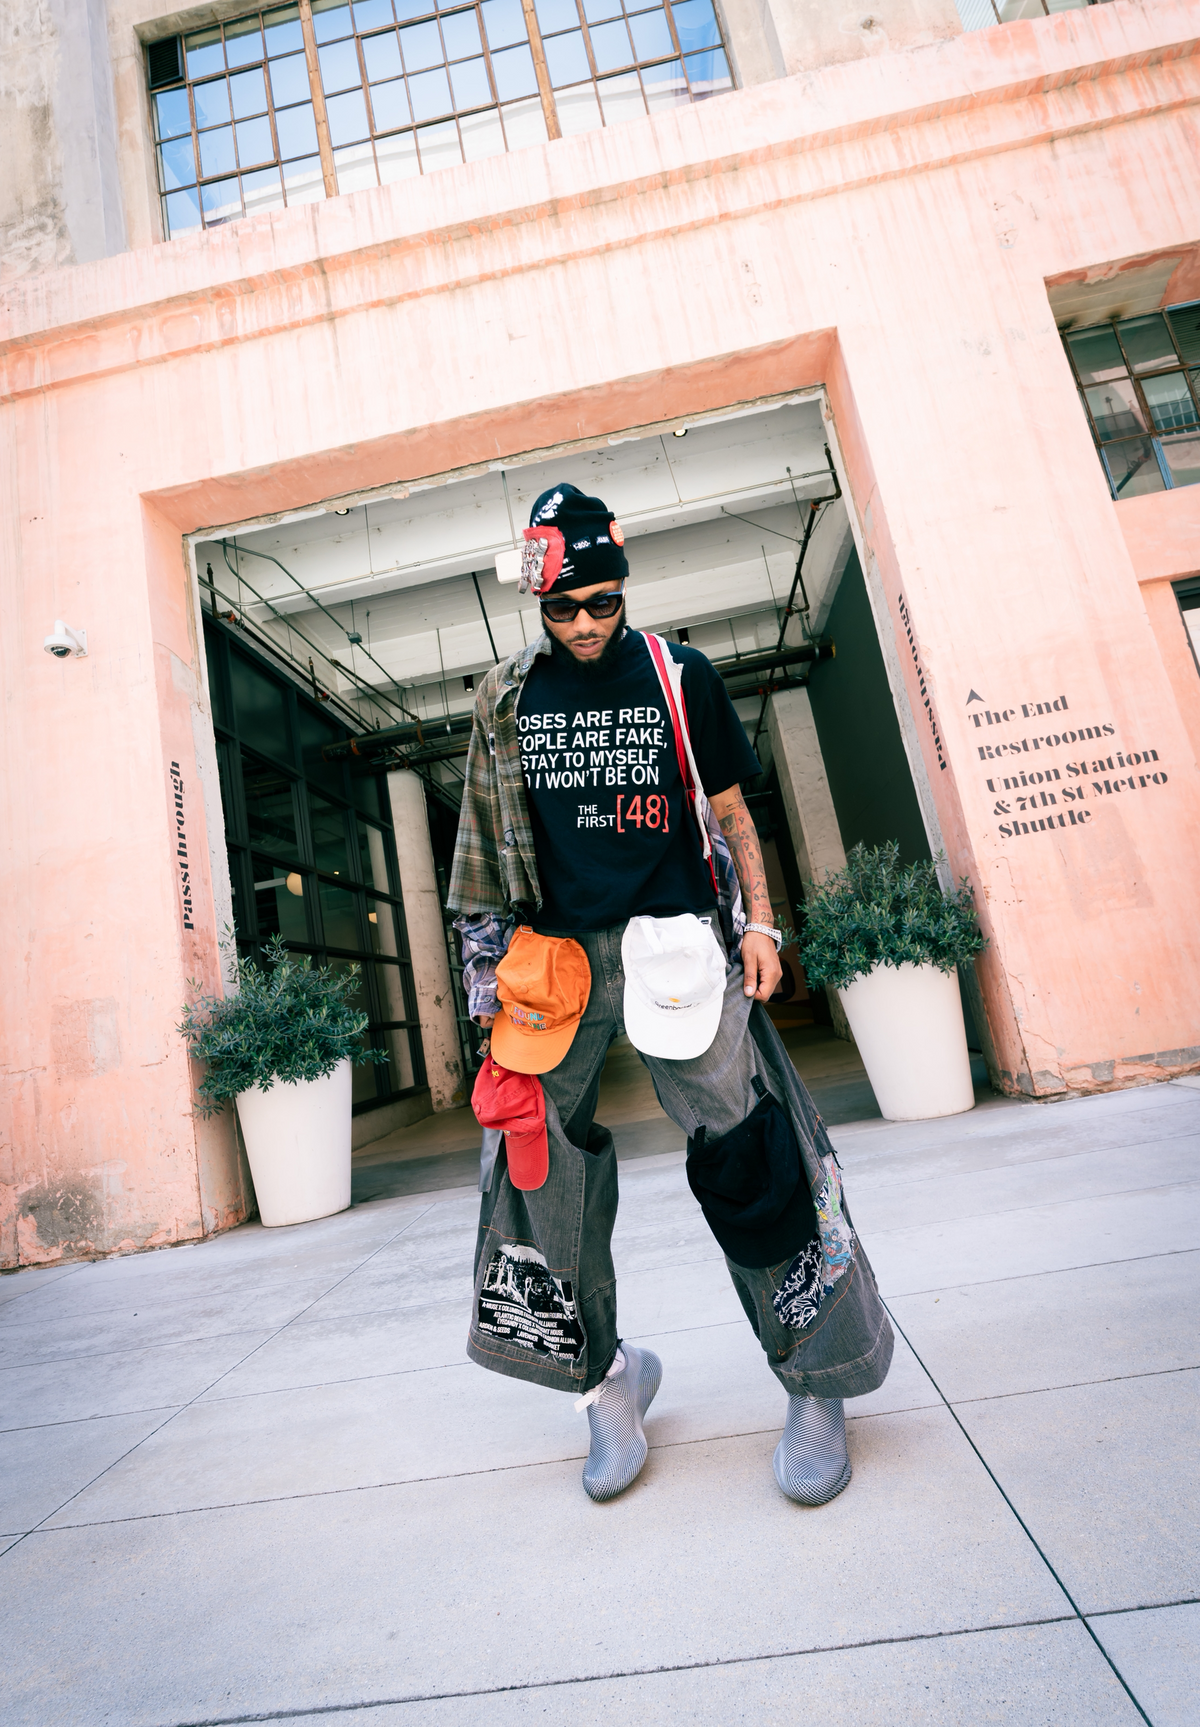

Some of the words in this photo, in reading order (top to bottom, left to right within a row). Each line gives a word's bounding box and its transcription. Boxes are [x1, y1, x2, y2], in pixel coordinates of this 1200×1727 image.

[516, 713, 567, 732] OSES
[572, 710, 613, 728] ARE
[619, 707, 665, 728] RED,
[968, 708, 1017, 728] The
[1021, 695, 1069, 718] End
[572, 730, 610, 748] ARE
[616, 728, 667, 748] FAKE,
[977, 723, 1115, 760] Restrooms
[521, 753, 559, 770] STAY
[563, 752, 585, 768] TO
[590, 749, 658, 767] MYSELF
[985, 769, 1061, 793] Union
[1065, 749, 1159, 778] Station
[535, 773, 540, 789] I
[545, 768, 600, 789] WON'T
[605, 766, 627, 786] BE
[631, 765, 659, 785] ON
[993, 800, 1012, 816] &
[1015, 791, 1058, 811] 7th
[1062, 784, 1088, 802] St
[1092, 771, 1168, 797] Metro
[577, 815, 616, 828] FIRST
[578, 804, 598, 815] THE
[998, 809, 1092, 839] Shuttle
[170, 761, 194, 930] Passthrough
[514, 1006, 544, 1021] FOUND
